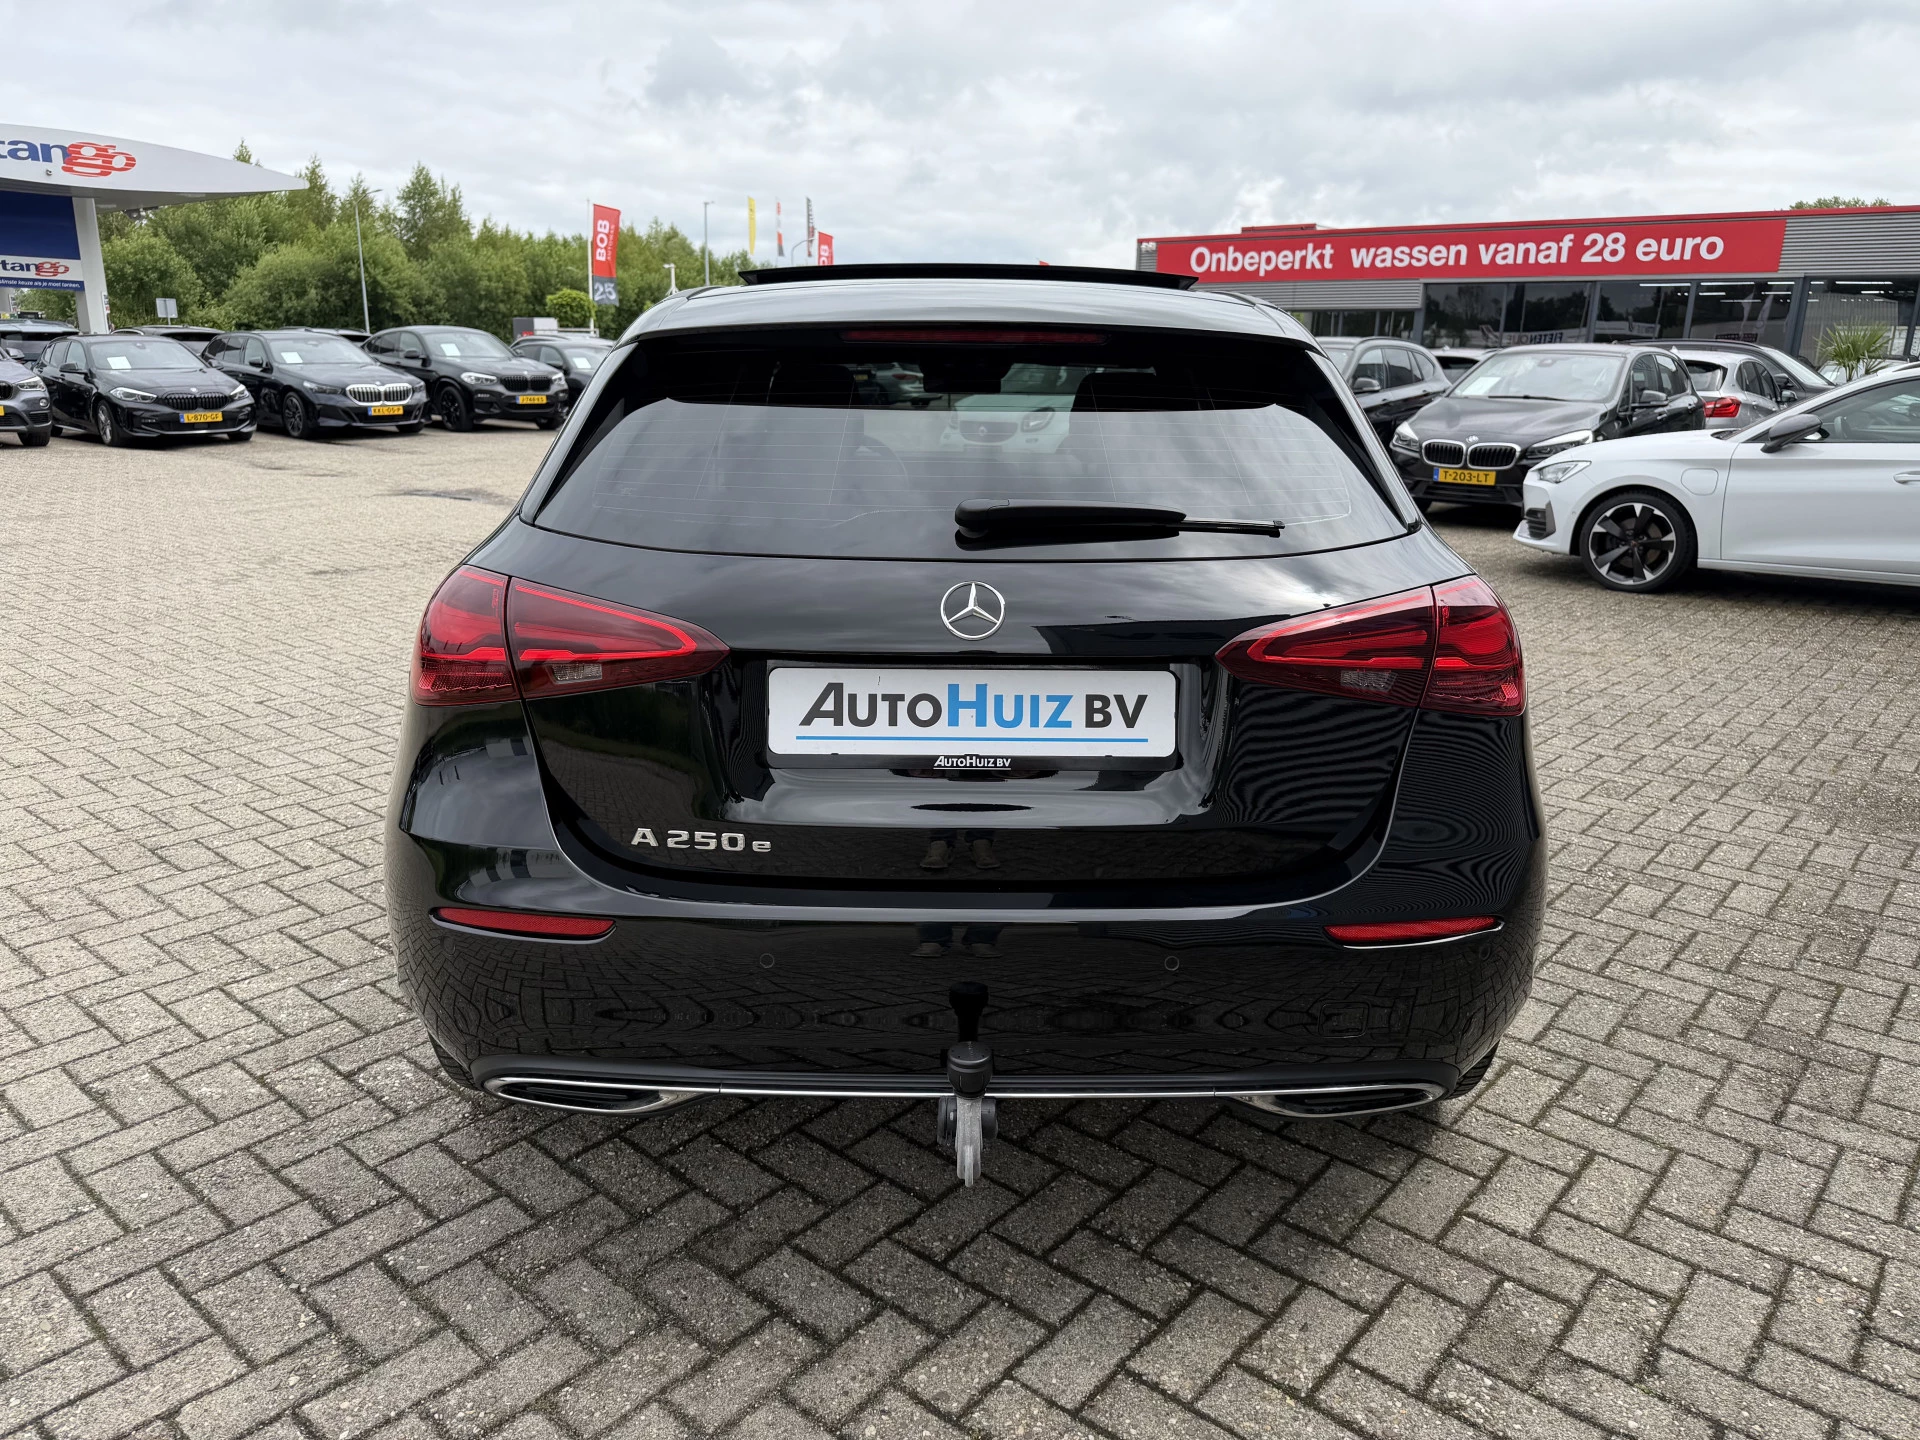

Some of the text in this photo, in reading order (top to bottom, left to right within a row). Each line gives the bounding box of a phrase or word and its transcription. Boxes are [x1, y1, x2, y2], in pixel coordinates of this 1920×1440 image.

[596, 219, 610, 262] BOB
[1189, 231, 1725, 277] Onbeperkt wassen vanaf 28 euro
[0, 260, 69, 277] tango
[1443, 470, 1490, 483] T-203-LT
[1084, 694, 1148, 728] BV
[996, 758, 1011, 767] BV
[630, 827, 659, 847] A
